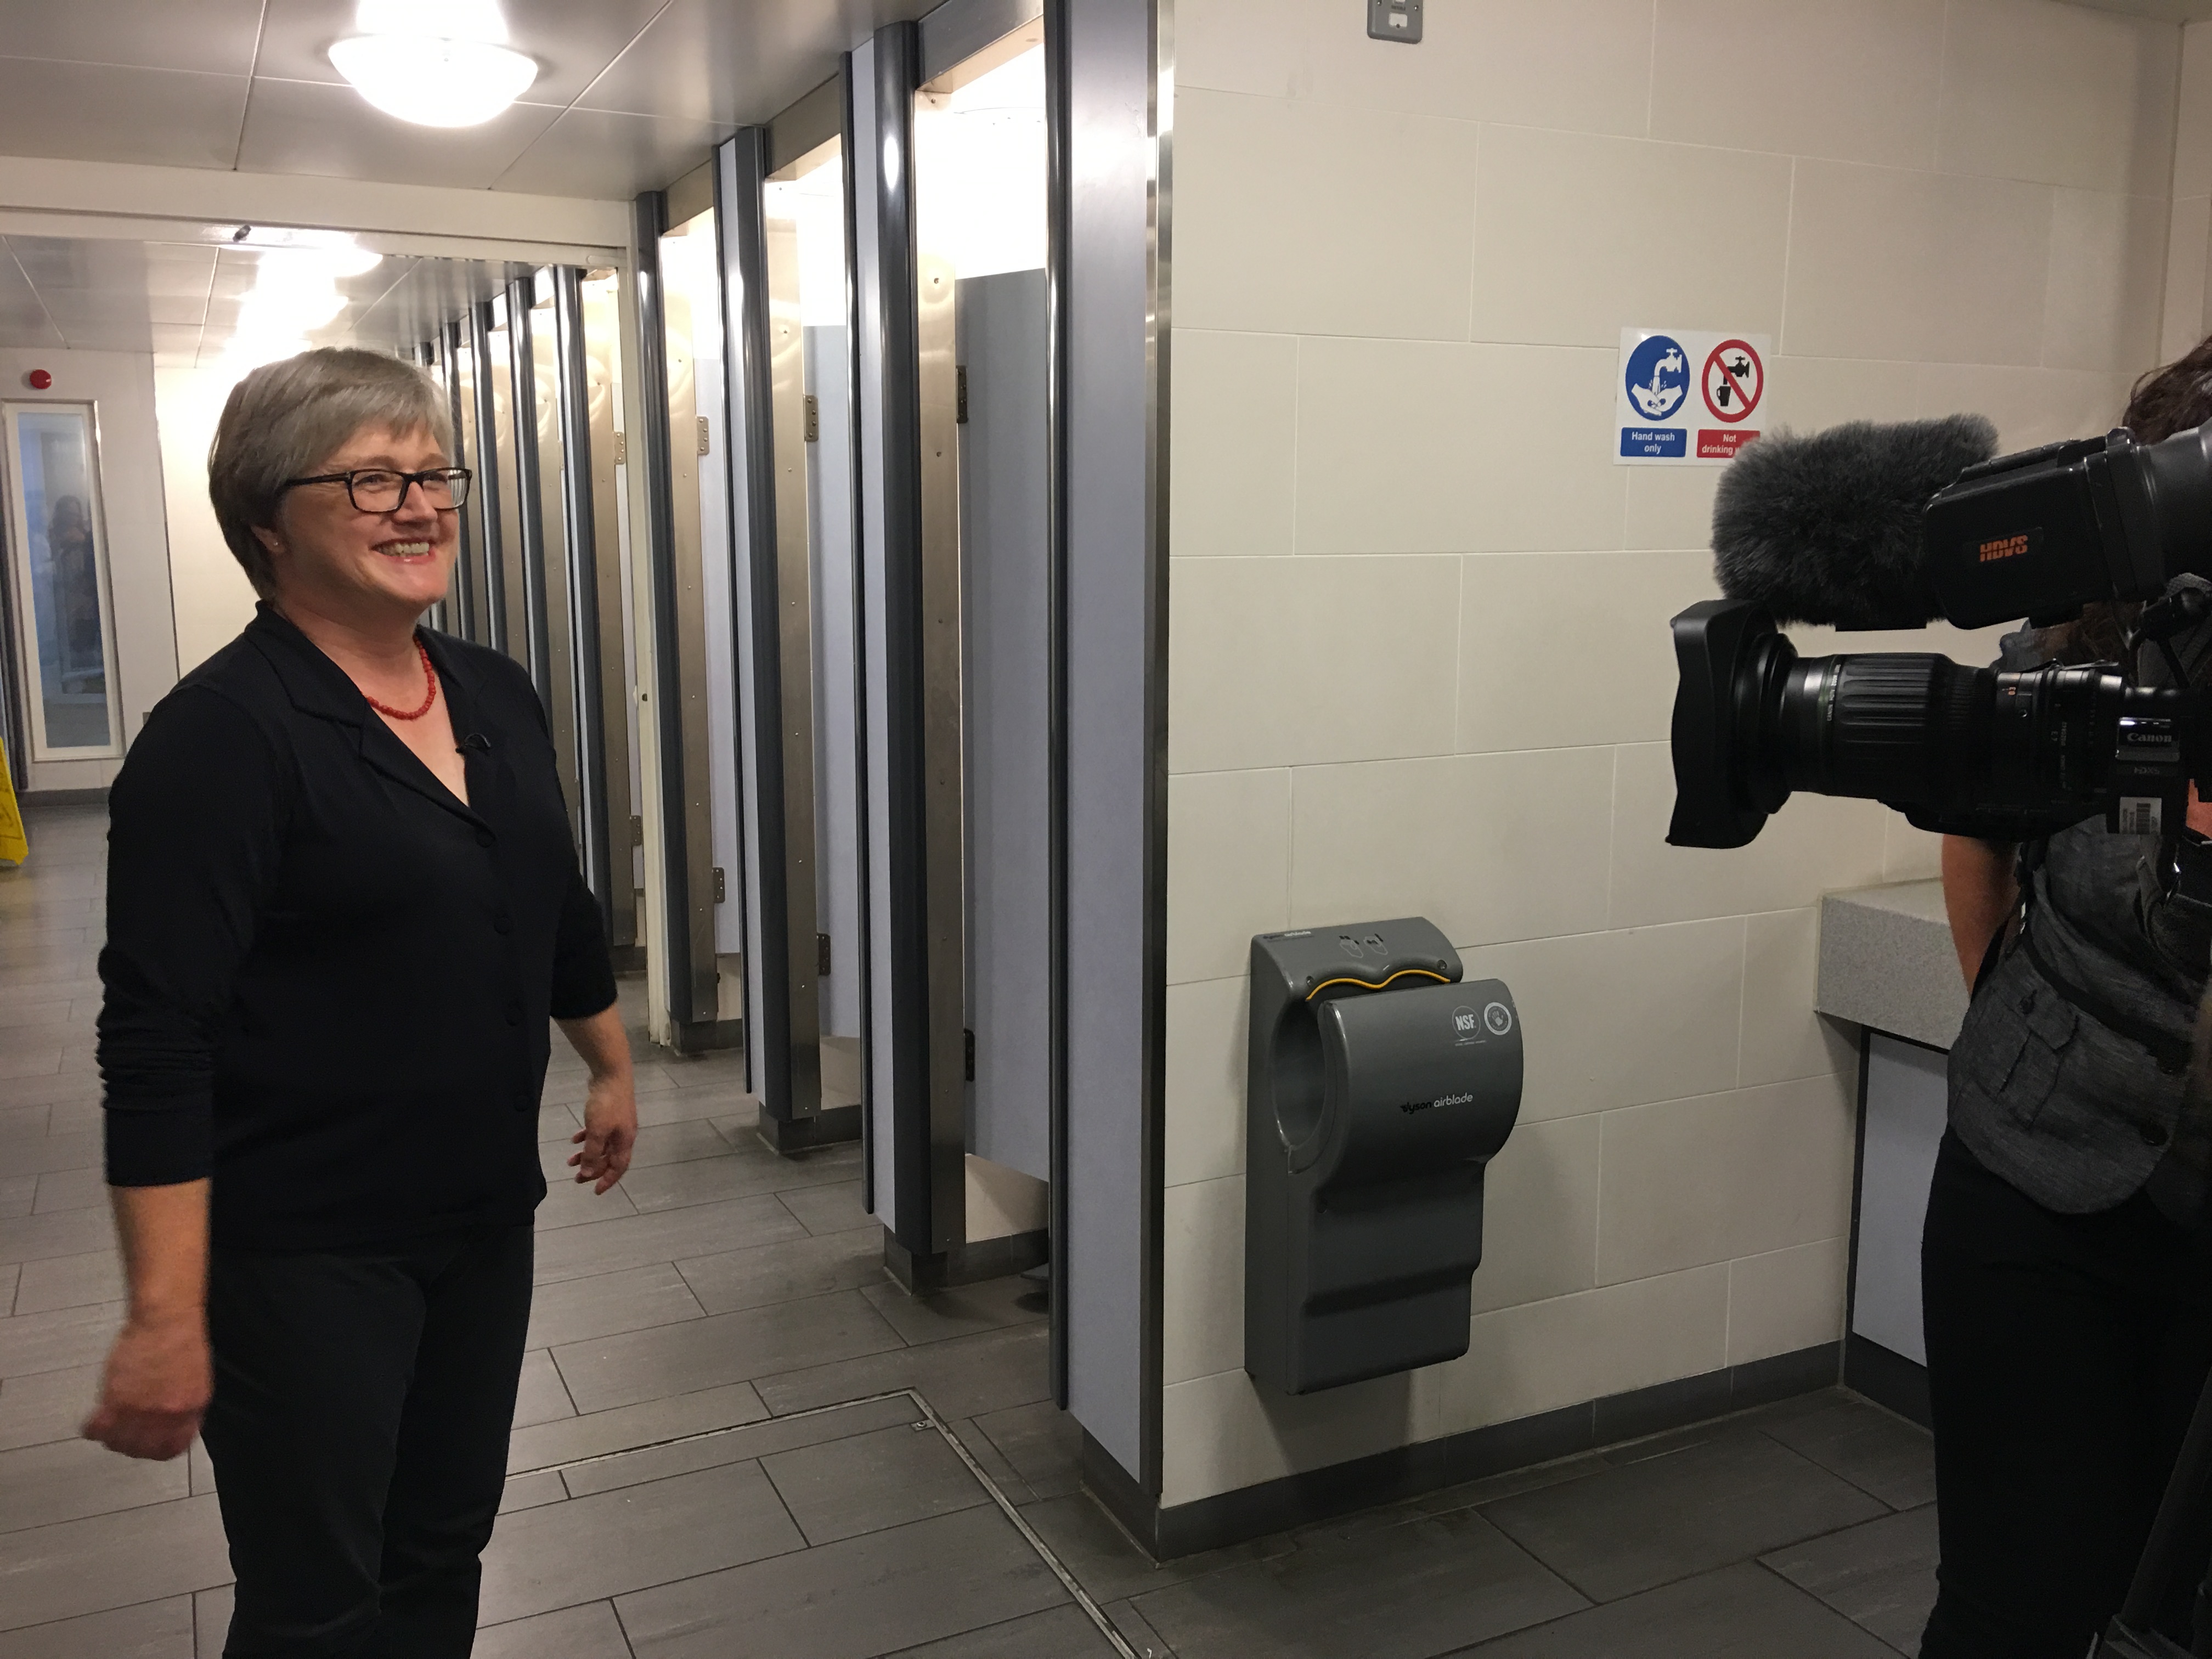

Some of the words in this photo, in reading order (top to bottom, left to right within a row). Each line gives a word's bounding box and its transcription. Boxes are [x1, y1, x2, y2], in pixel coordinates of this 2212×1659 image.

[1632, 431, 1653, 441] Hand
[1655, 432, 1675, 441] wash
[1723, 434, 1736, 442] Not
[1644, 443, 1662, 455] only
[1702, 444, 1733, 455] drinking
[1979, 534, 2028, 562] HDVS
[2127, 732, 2172, 743] Canon
[1455, 1014, 1475, 1030] NSF
[1400, 1102, 1432, 1115] dyson
[1434, 1092, 1473, 1108] airblade
